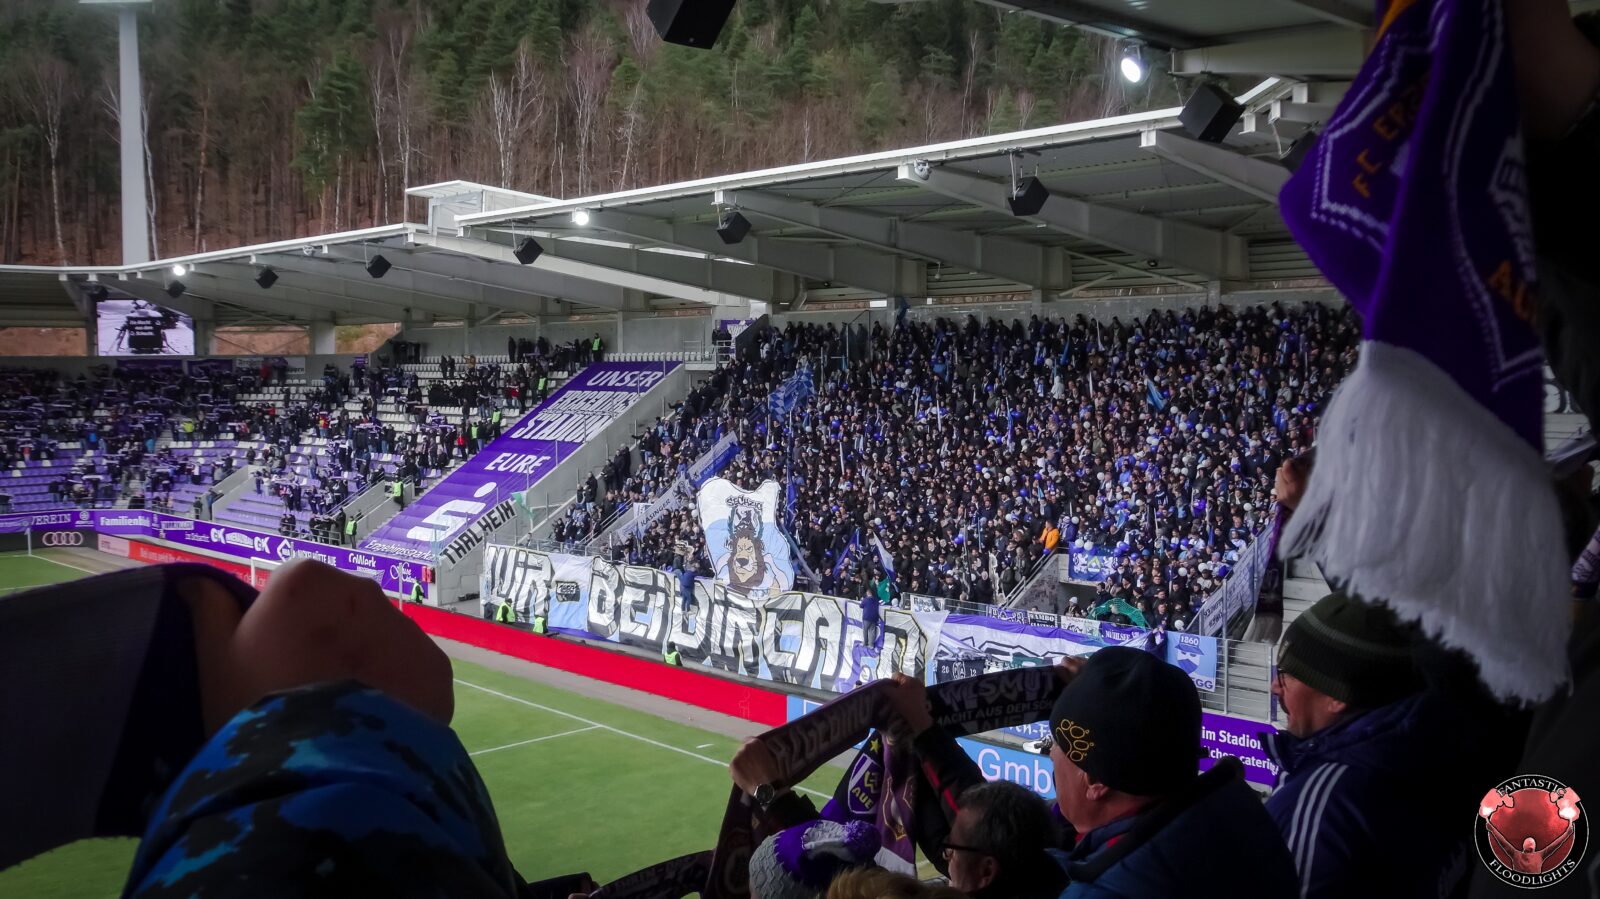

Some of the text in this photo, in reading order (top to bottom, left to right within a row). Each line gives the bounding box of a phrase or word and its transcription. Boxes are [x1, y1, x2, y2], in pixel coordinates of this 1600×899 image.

[586, 370, 664, 387] UNSER
[484, 452, 552, 475] EURE
[1180, 635, 1199, 646] 1860
[969, 668, 977, 677] 12
[1201, 726, 1216, 741] im
[851, 786, 874, 810] AUE
